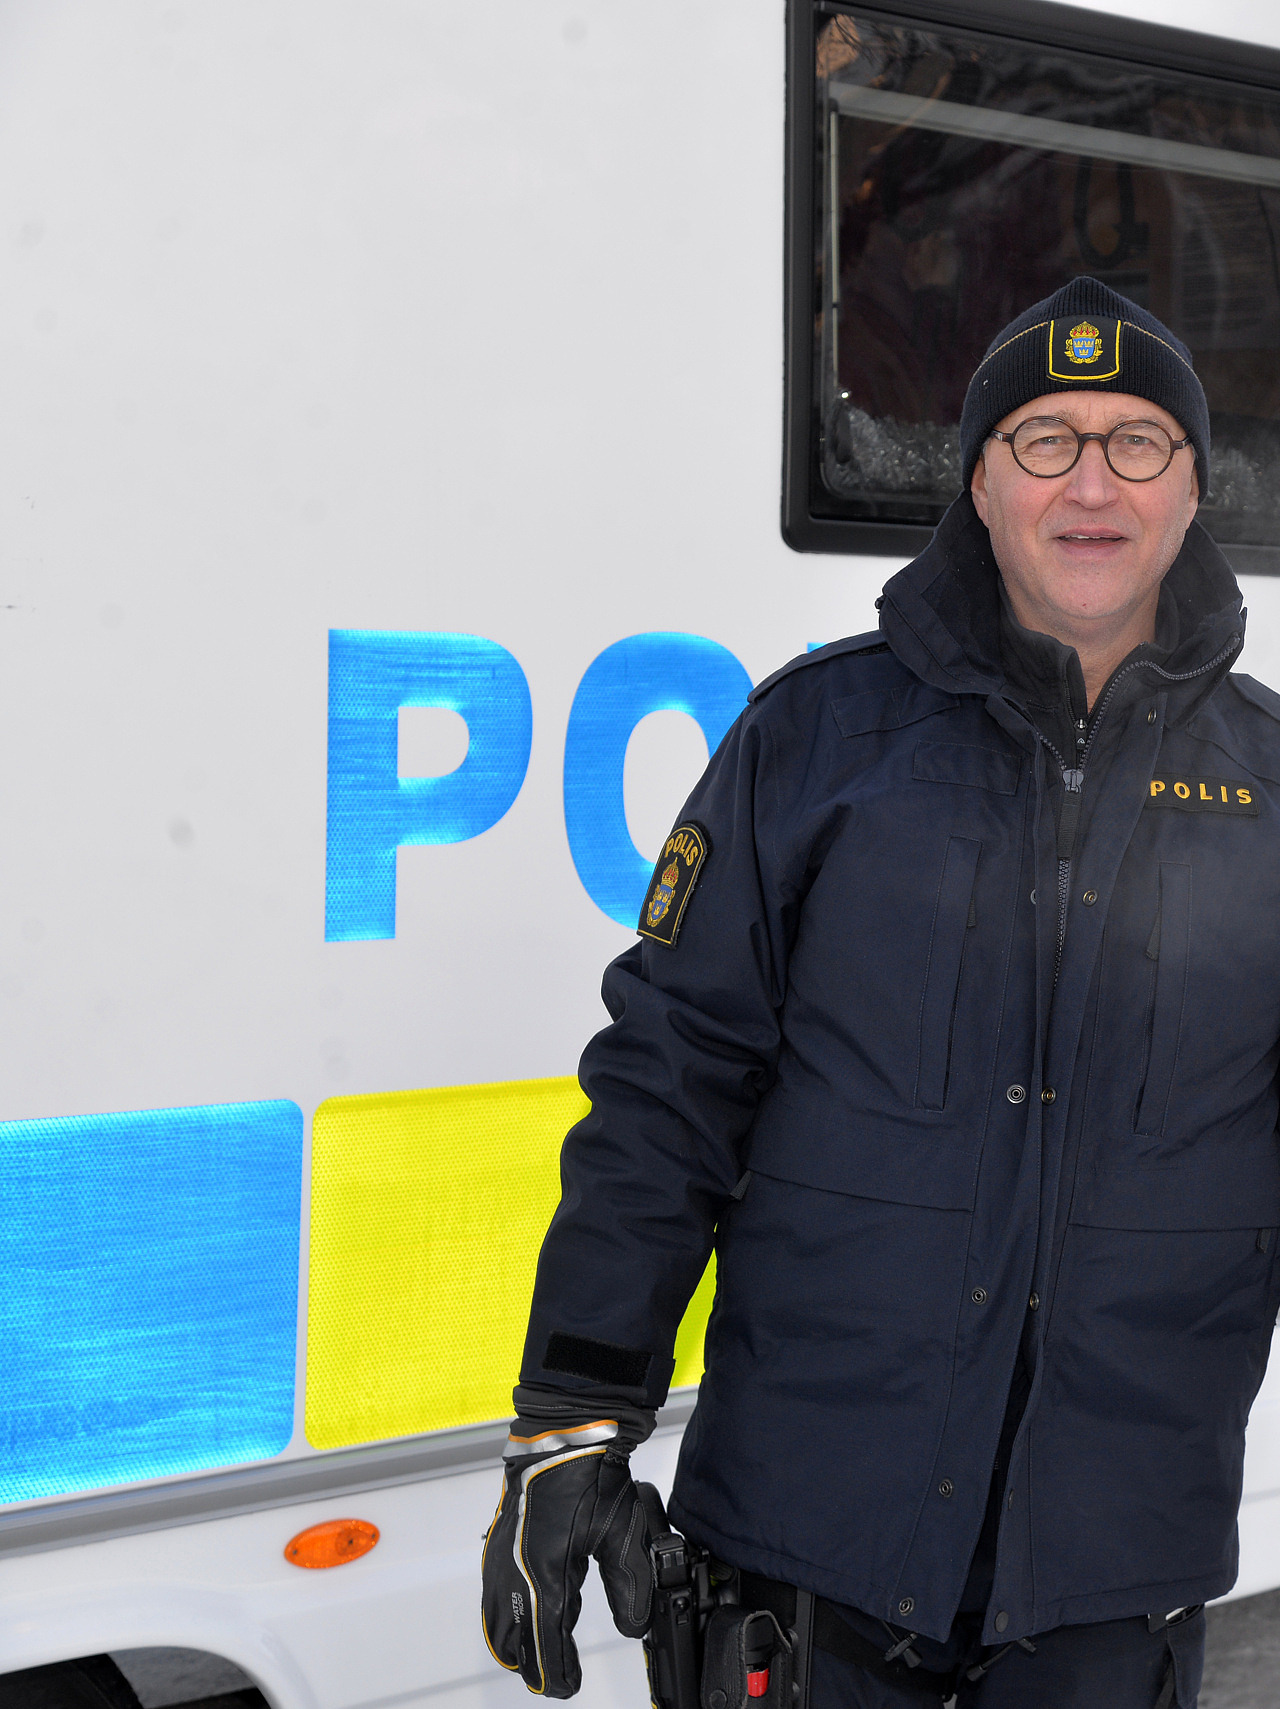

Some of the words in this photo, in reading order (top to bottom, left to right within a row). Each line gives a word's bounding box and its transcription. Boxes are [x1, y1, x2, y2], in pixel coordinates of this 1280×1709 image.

[1150, 780, 1252, 804] POLIS
[664, 833, 699, 866] POLIS
[511, 1591, 520, 1624] WATER
